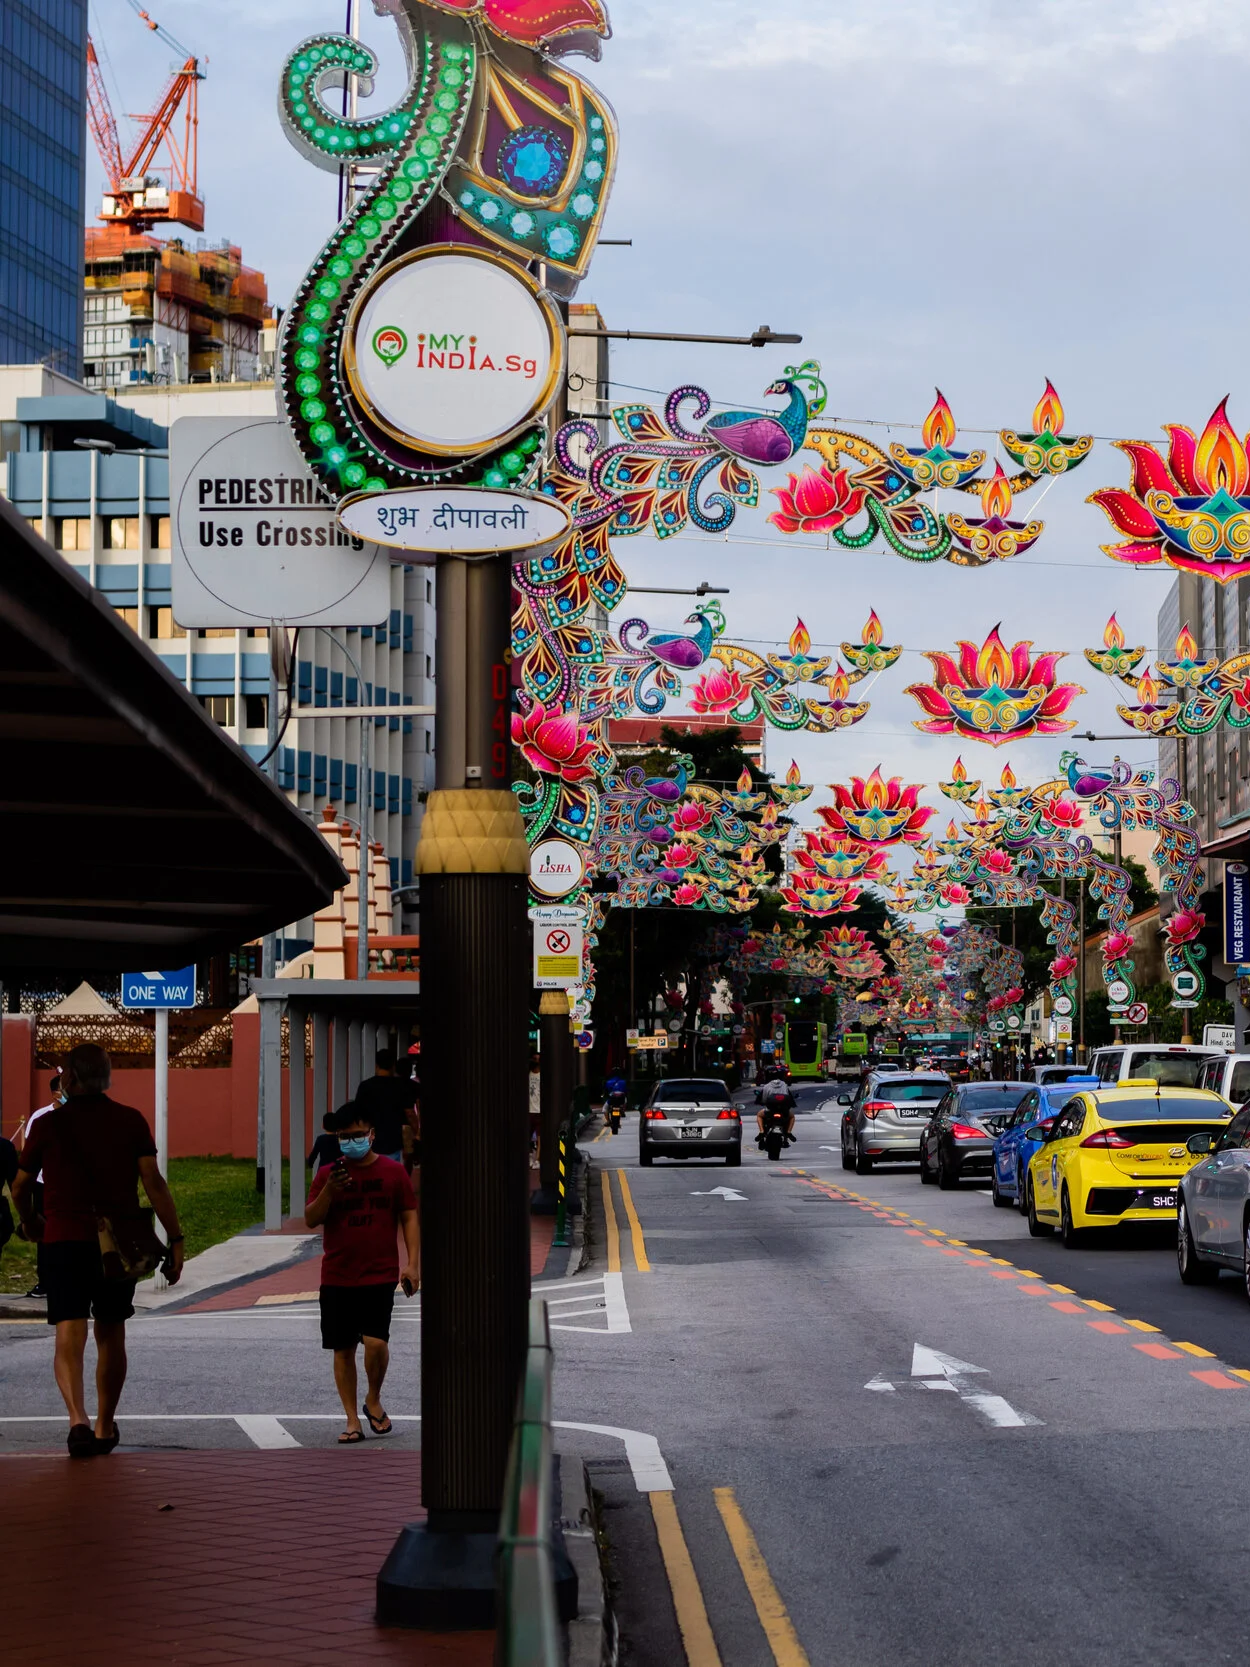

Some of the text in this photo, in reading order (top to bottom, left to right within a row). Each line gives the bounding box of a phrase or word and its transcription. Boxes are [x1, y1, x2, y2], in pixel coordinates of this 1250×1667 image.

[199, 478, 336, 504] PEDESTRIA
[377, 502, 529, 536] शुभ दीपावली
[199, 521, 243, 547] Use
[1233, 876, 1243, 938] RESTAURANT
[128, 985, 189, 1000] ONE WAY
[1153, 1196, 1177, 1206] SHC
